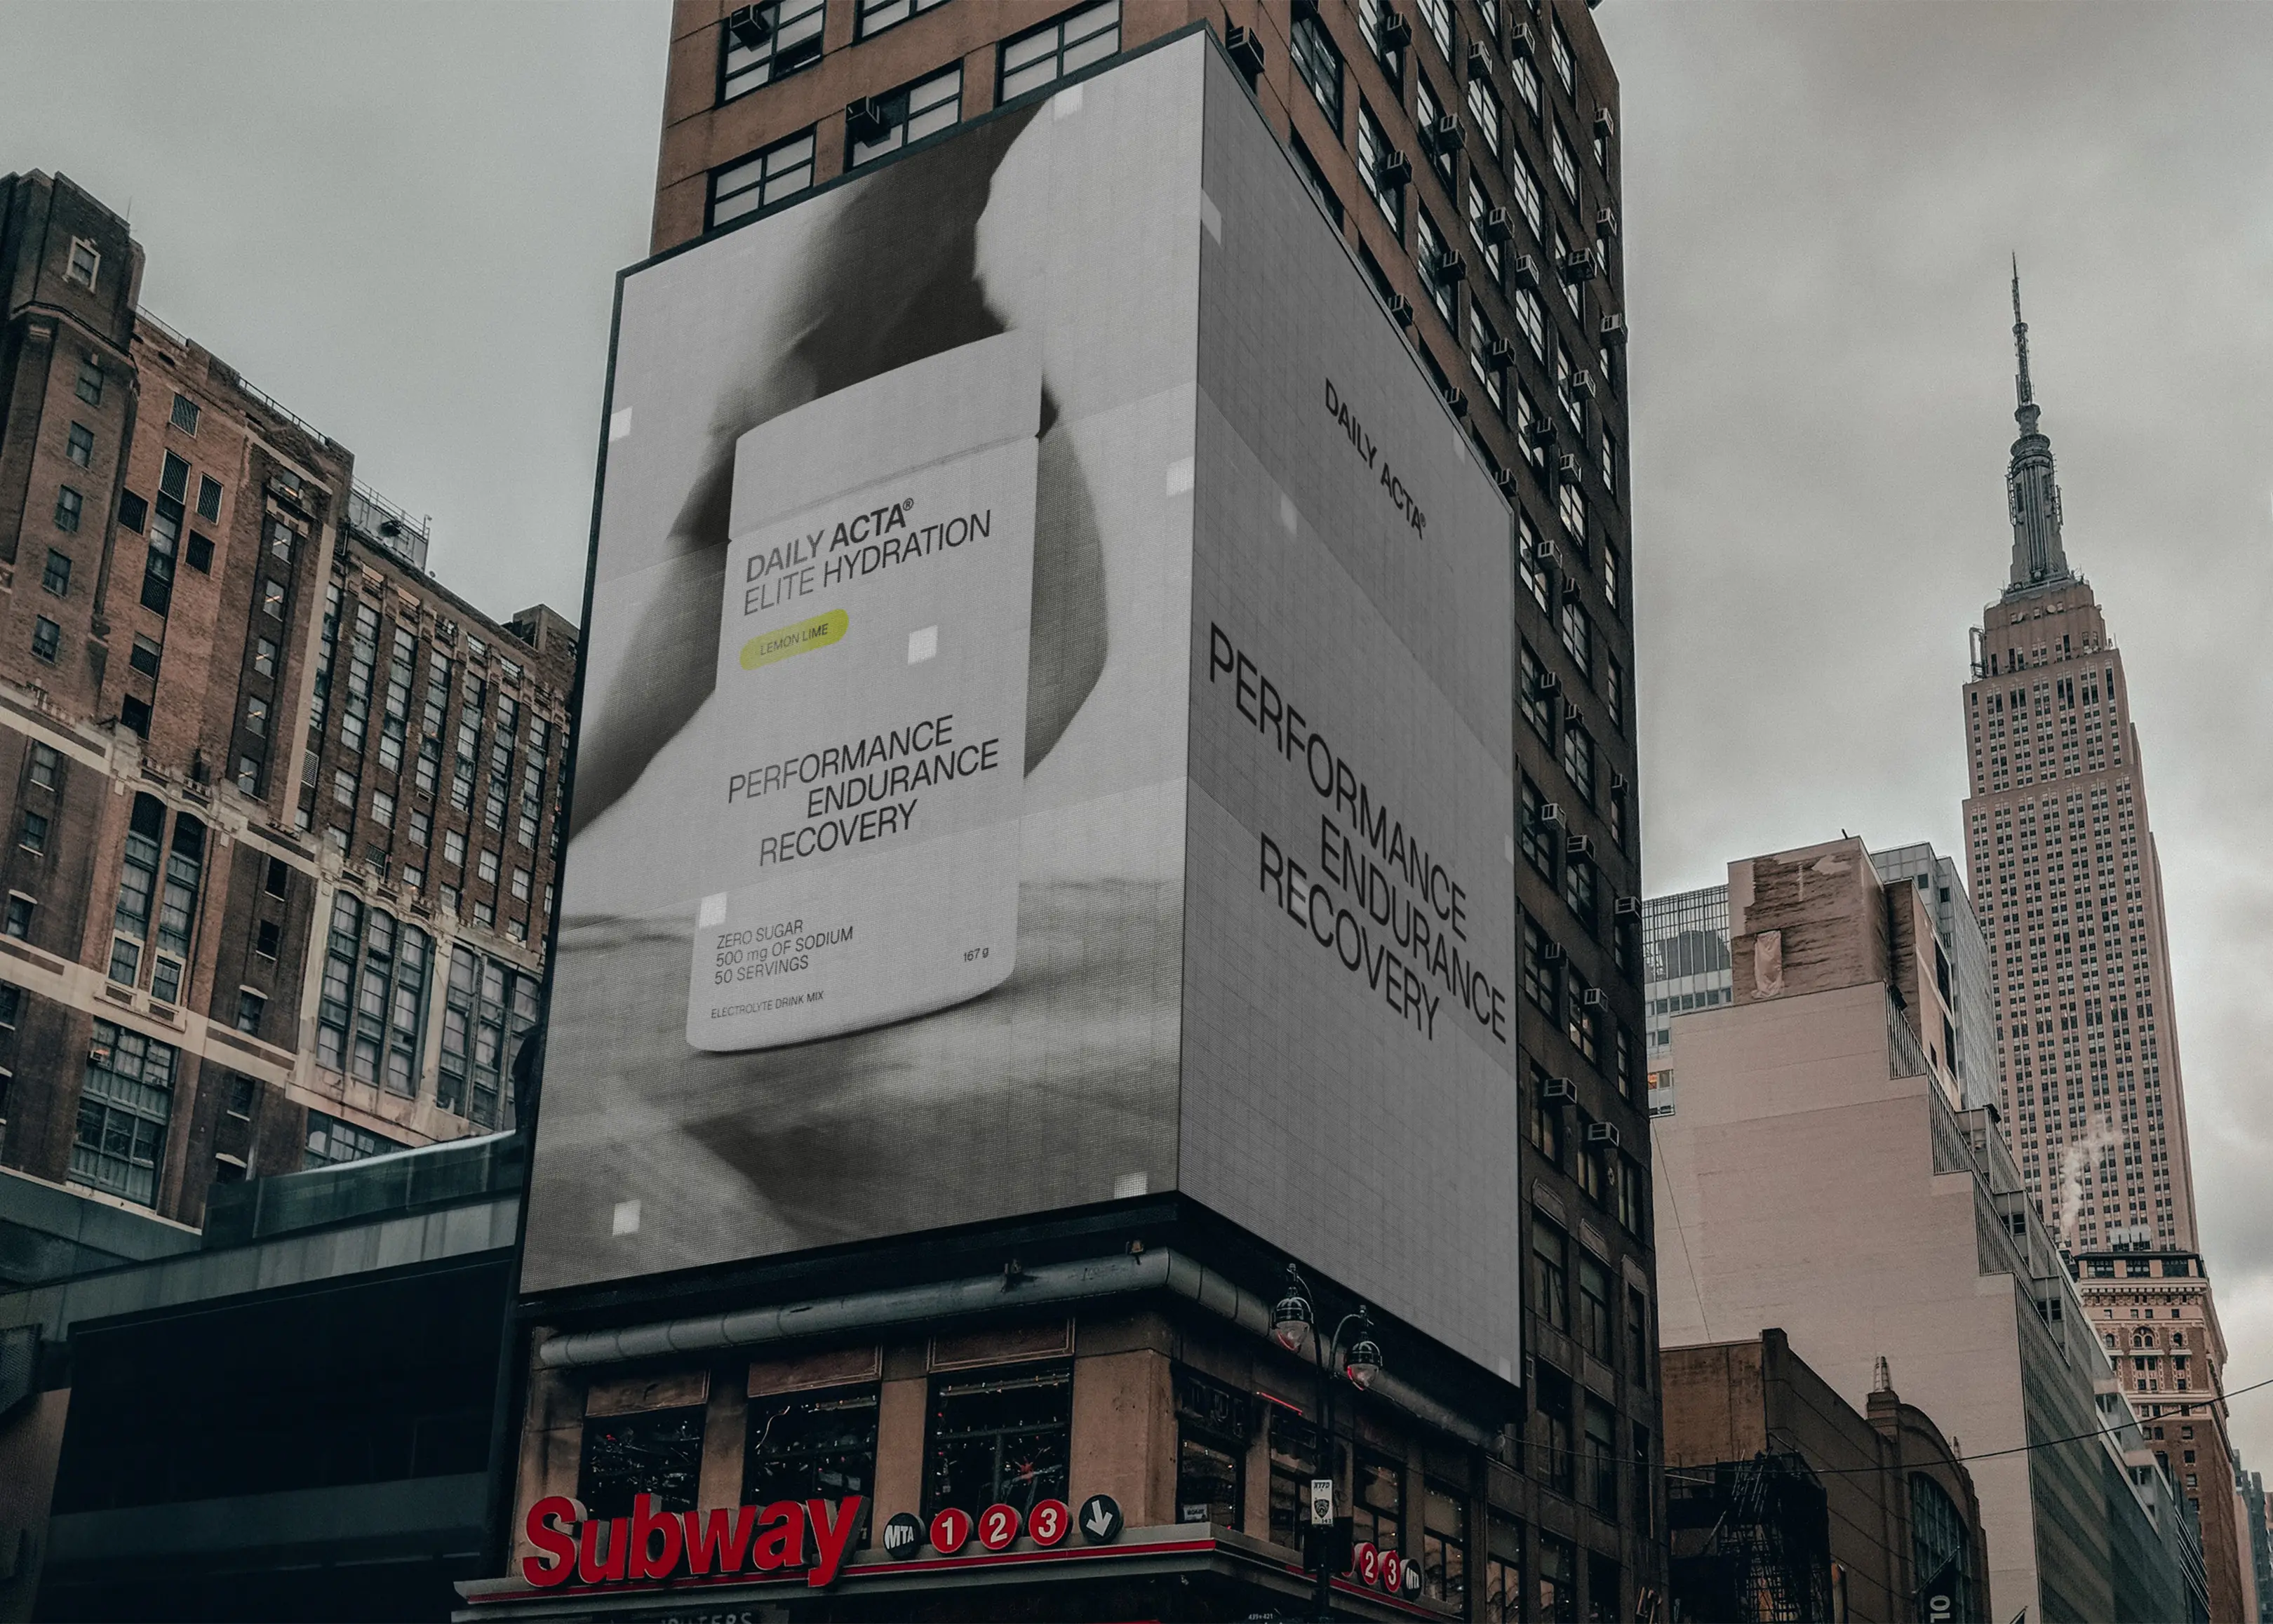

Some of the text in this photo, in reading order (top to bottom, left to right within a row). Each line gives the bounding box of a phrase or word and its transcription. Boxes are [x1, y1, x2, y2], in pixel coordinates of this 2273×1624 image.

[1326, 377, 1377, 469] DAILY
[744, 509, 991, 616] ELITE HYDRATION
[746, 530, 824, 583] DAILY
[760, 624, 829, 656] LEMON LIME
[728, 714, 953, 804] PERFORMANCE
[807, 738, 1000, 819] ENDURANCE
[1209, 620, 1467, 943] PERFORMANCE
[759, 799, 918, 867] RECOVERY
[716, 920, 804, 950] ZERO SUGAR
[716, 925, 854, 967] 500 mg OF SODIUM
[963, 948, 989, 962] 167 g
[1260, 832, 1440, 1041] RECOVERY
[1321, 814, 1506, 1045] ENDURANCE
[714, 954, 810, 985] 50 SERVINGS
[711, 990, 824, 1019] ELECTROLYTE DRINK MIX
[522, 1492, 865, 1588] Subway
[884, 1508, 1057, 1549] MTA 1 2 3
[1365, 1550, 1374, 1578] 2
[1388, 1558, 1397, 1585] 3
